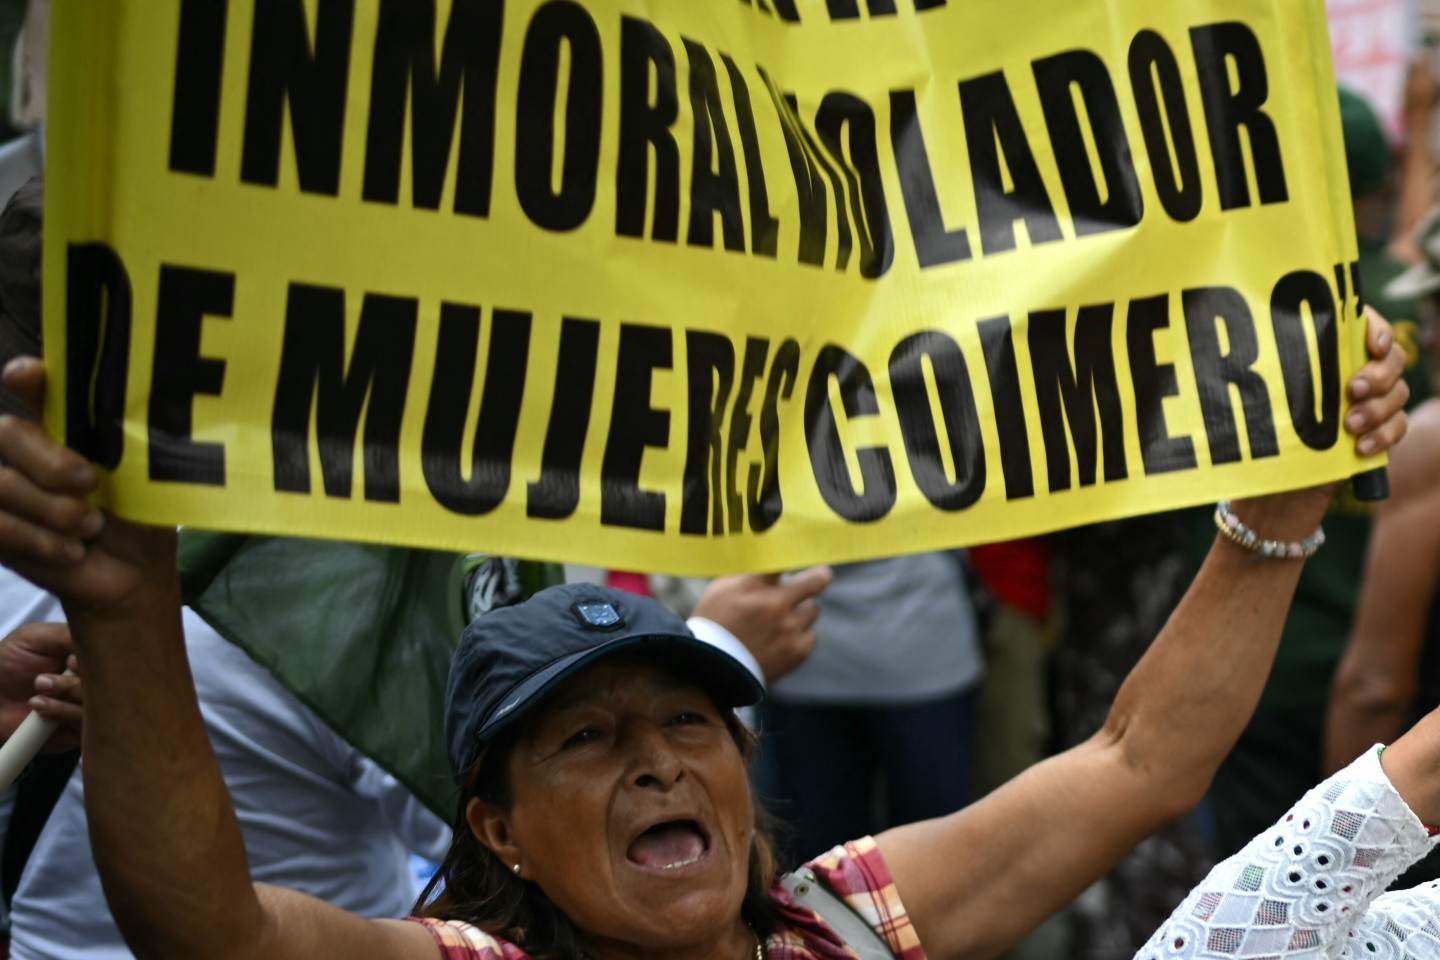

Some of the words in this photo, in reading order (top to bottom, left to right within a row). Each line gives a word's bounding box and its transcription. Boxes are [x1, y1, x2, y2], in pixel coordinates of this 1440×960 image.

[168, 0, 780, 260] INMORAL
[65, 240, 237, 486] DE
[271, 281, 801, 537] MUJERES
